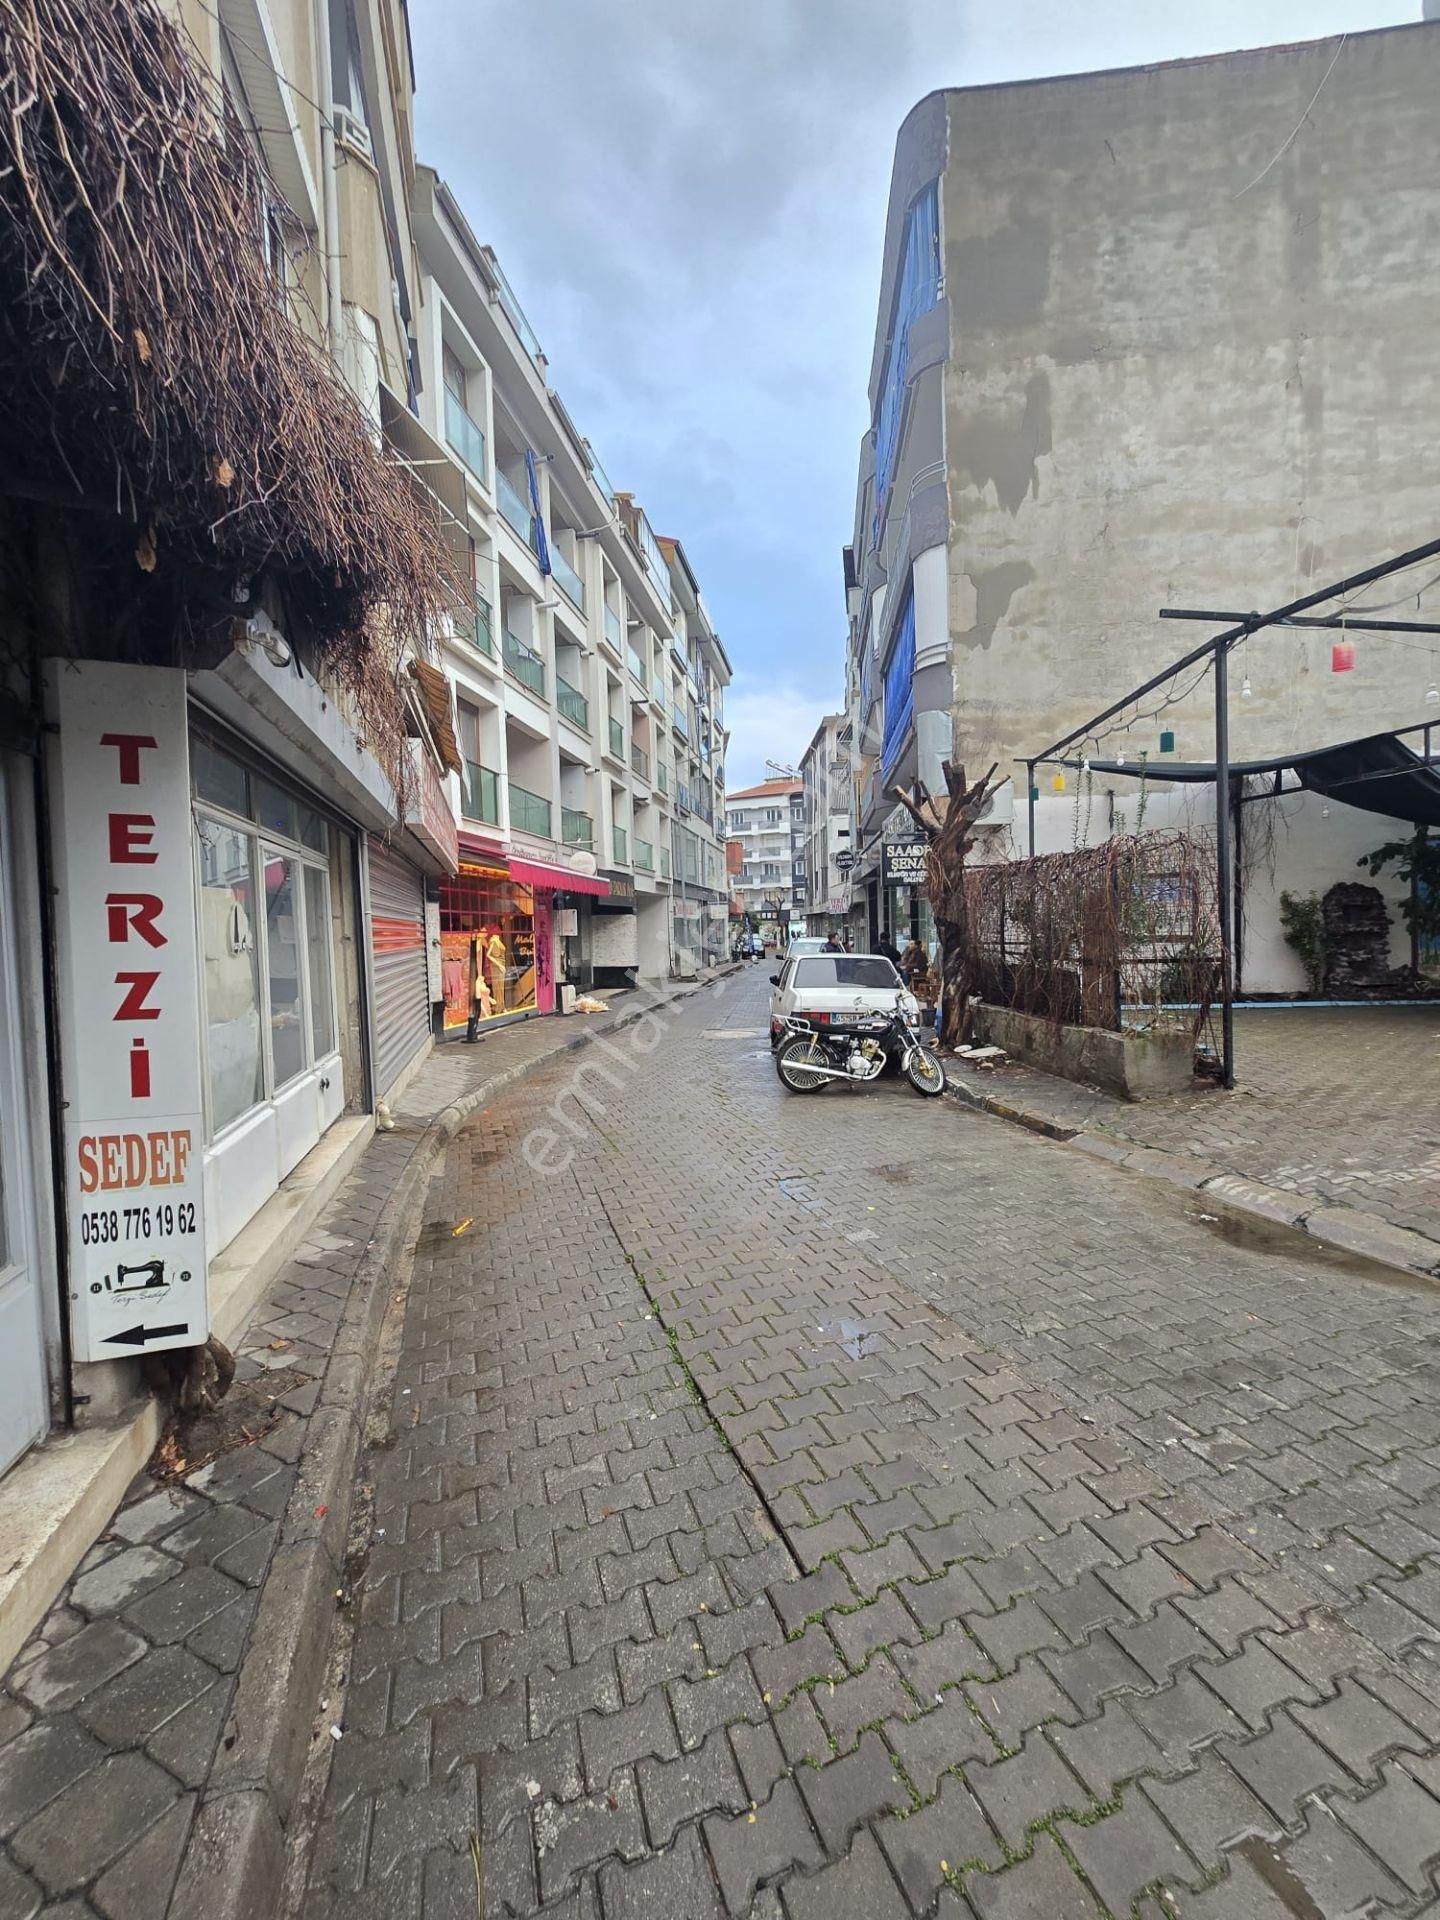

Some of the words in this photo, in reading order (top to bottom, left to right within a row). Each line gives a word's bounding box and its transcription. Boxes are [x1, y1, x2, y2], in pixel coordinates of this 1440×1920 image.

[99, 733, 168, 1098] TERZİ
[78, 1129, 192, 1193] SEDEF
[81, 1209, 118, 1245] 0538
[123, 1206, 151, 1240] 776
[156, 1204, 173, 1236] 19
[178, 1202, 196, 1235] 62
